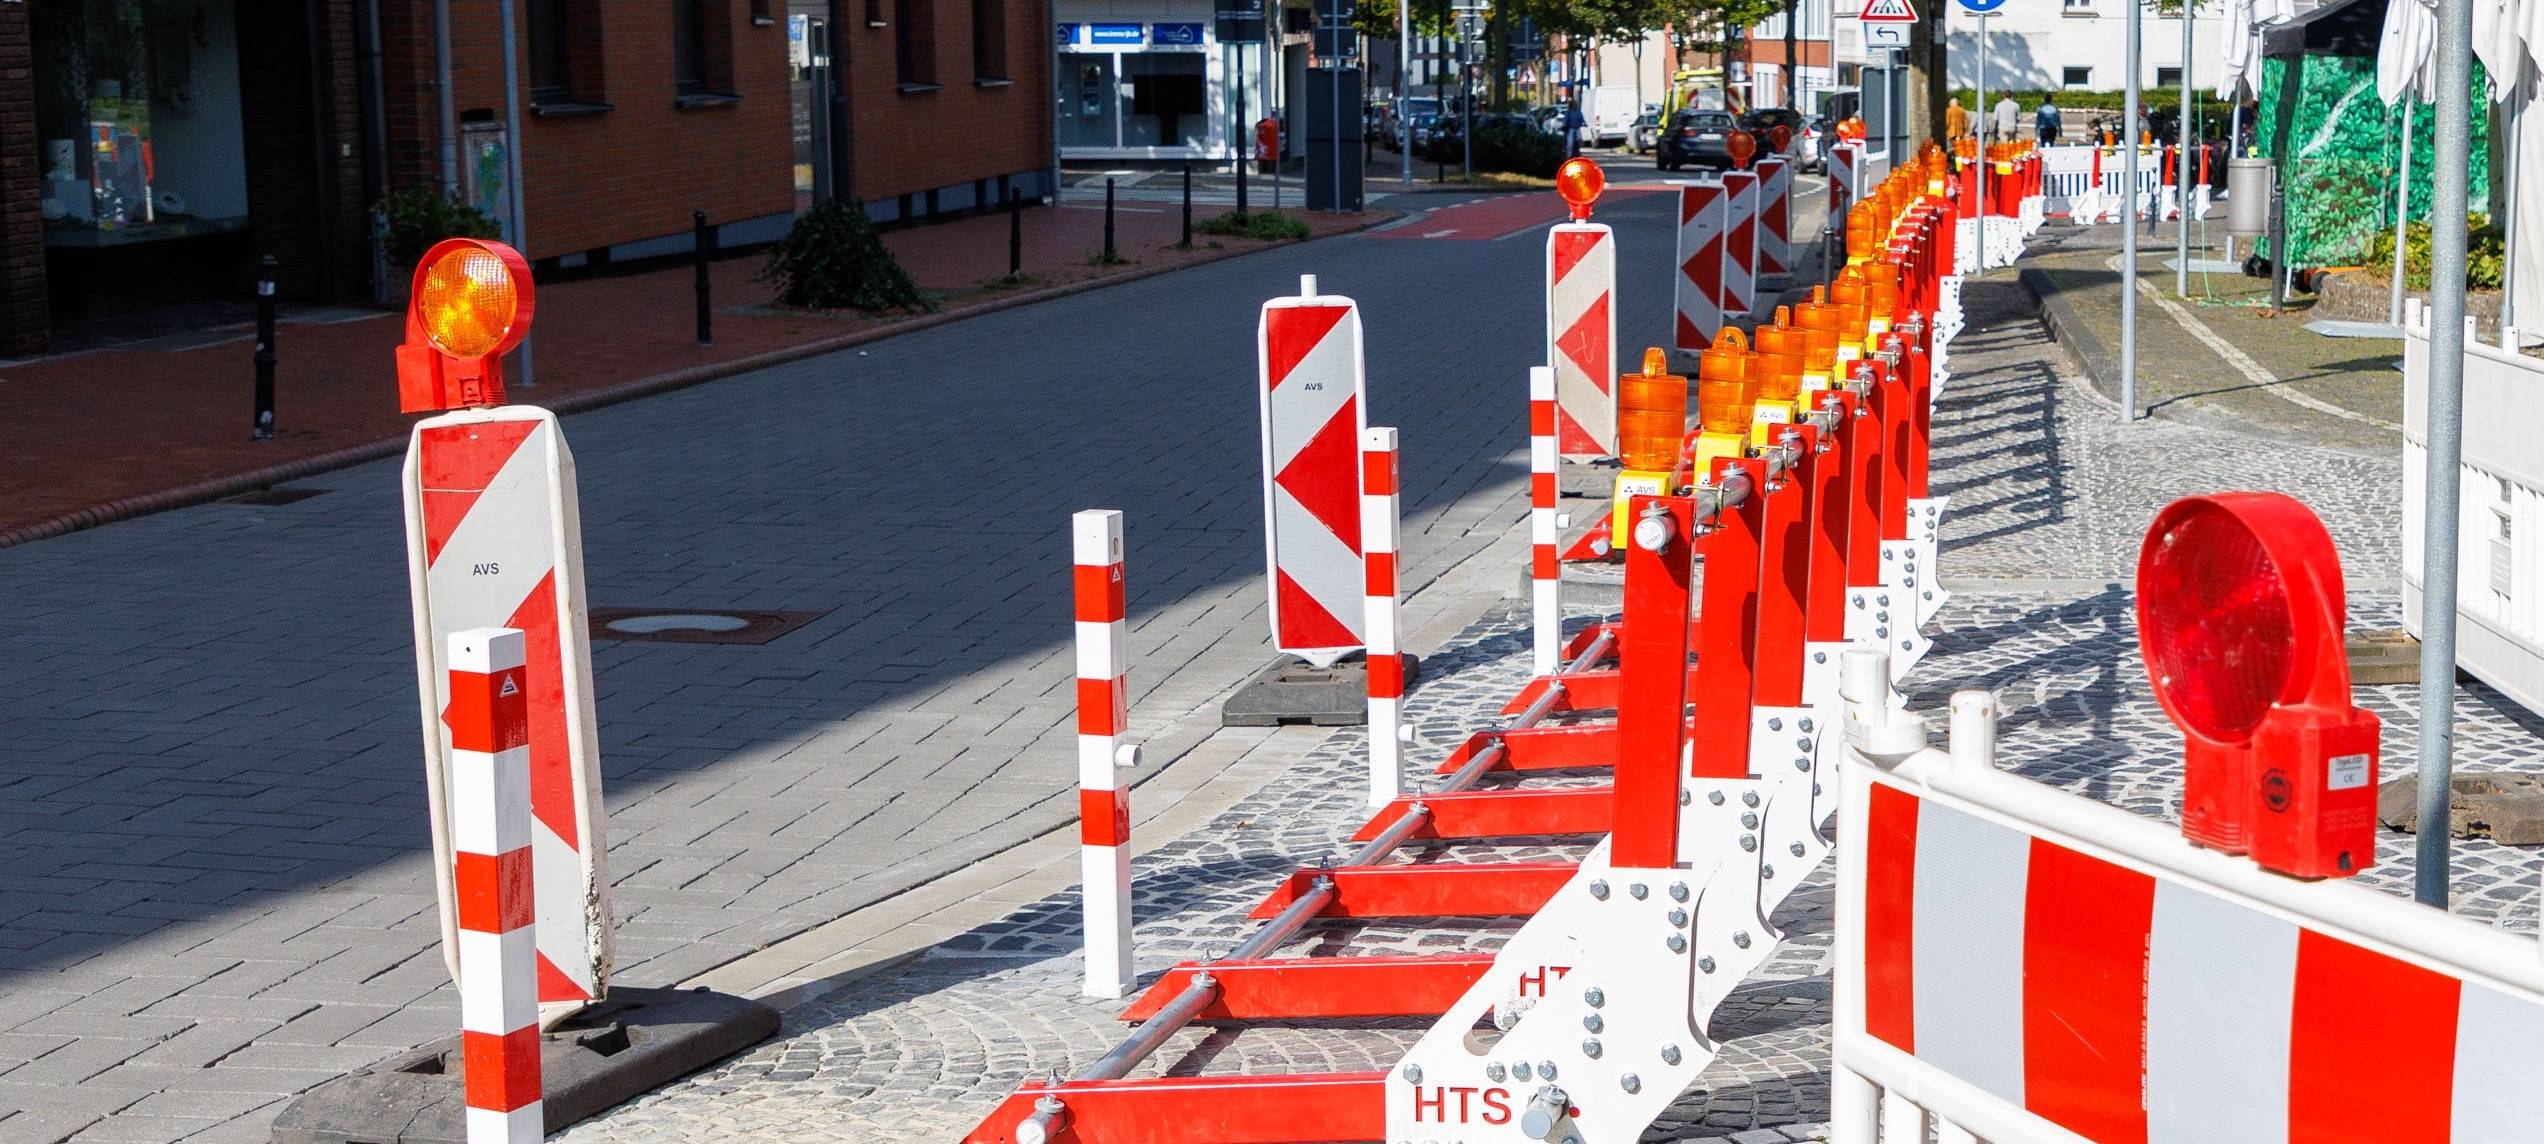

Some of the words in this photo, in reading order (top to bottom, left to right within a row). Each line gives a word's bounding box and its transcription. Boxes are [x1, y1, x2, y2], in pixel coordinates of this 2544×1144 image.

[1304, 383, 1323, 391] AVS
[1636, 486, 1655, 494] AVS
[472, 562, 499, 576] AVS
[2343, 774, 2354, 783] CE
[1415, 1086, 1512, 1125] HTS
